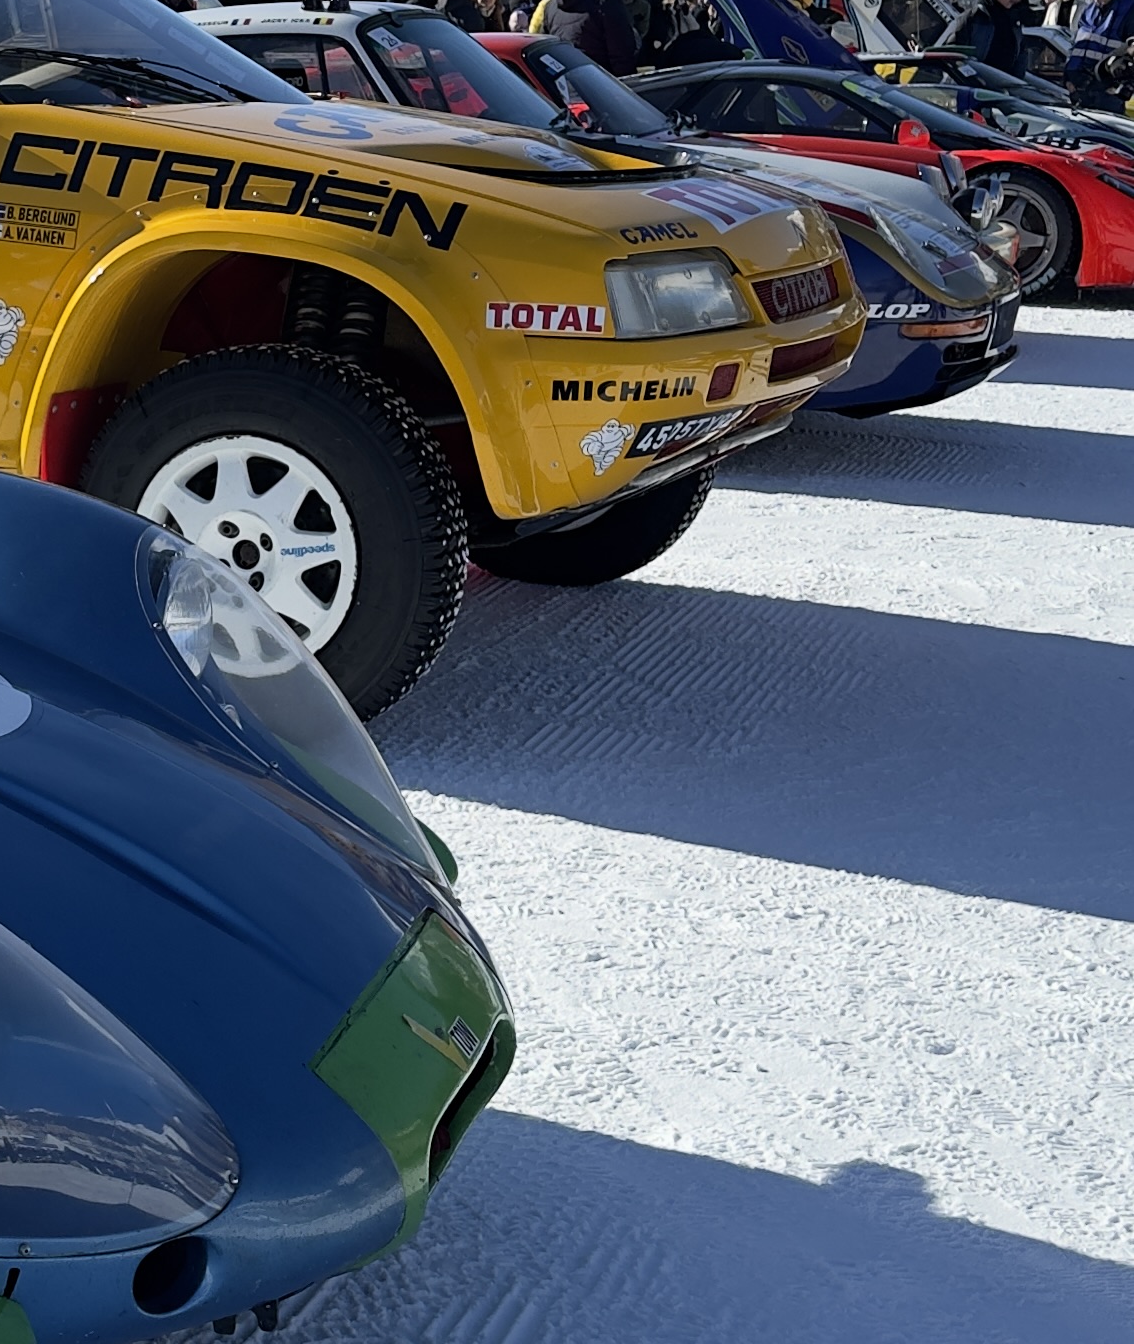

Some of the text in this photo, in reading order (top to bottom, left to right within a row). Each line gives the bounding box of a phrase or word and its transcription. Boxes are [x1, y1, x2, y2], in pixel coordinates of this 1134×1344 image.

[381, 35, 398, 47] 26
[6, 205, 76, 227] B. BERGLUND
[3, 224, 66, 246] A. VATANEN
[619, 222, 698, 246] CAMEL
[489, 302, 605, 334] TOTAL
[551, 375, 697, 403] MICHELIN
[280, 542, 336, 557] speedline
